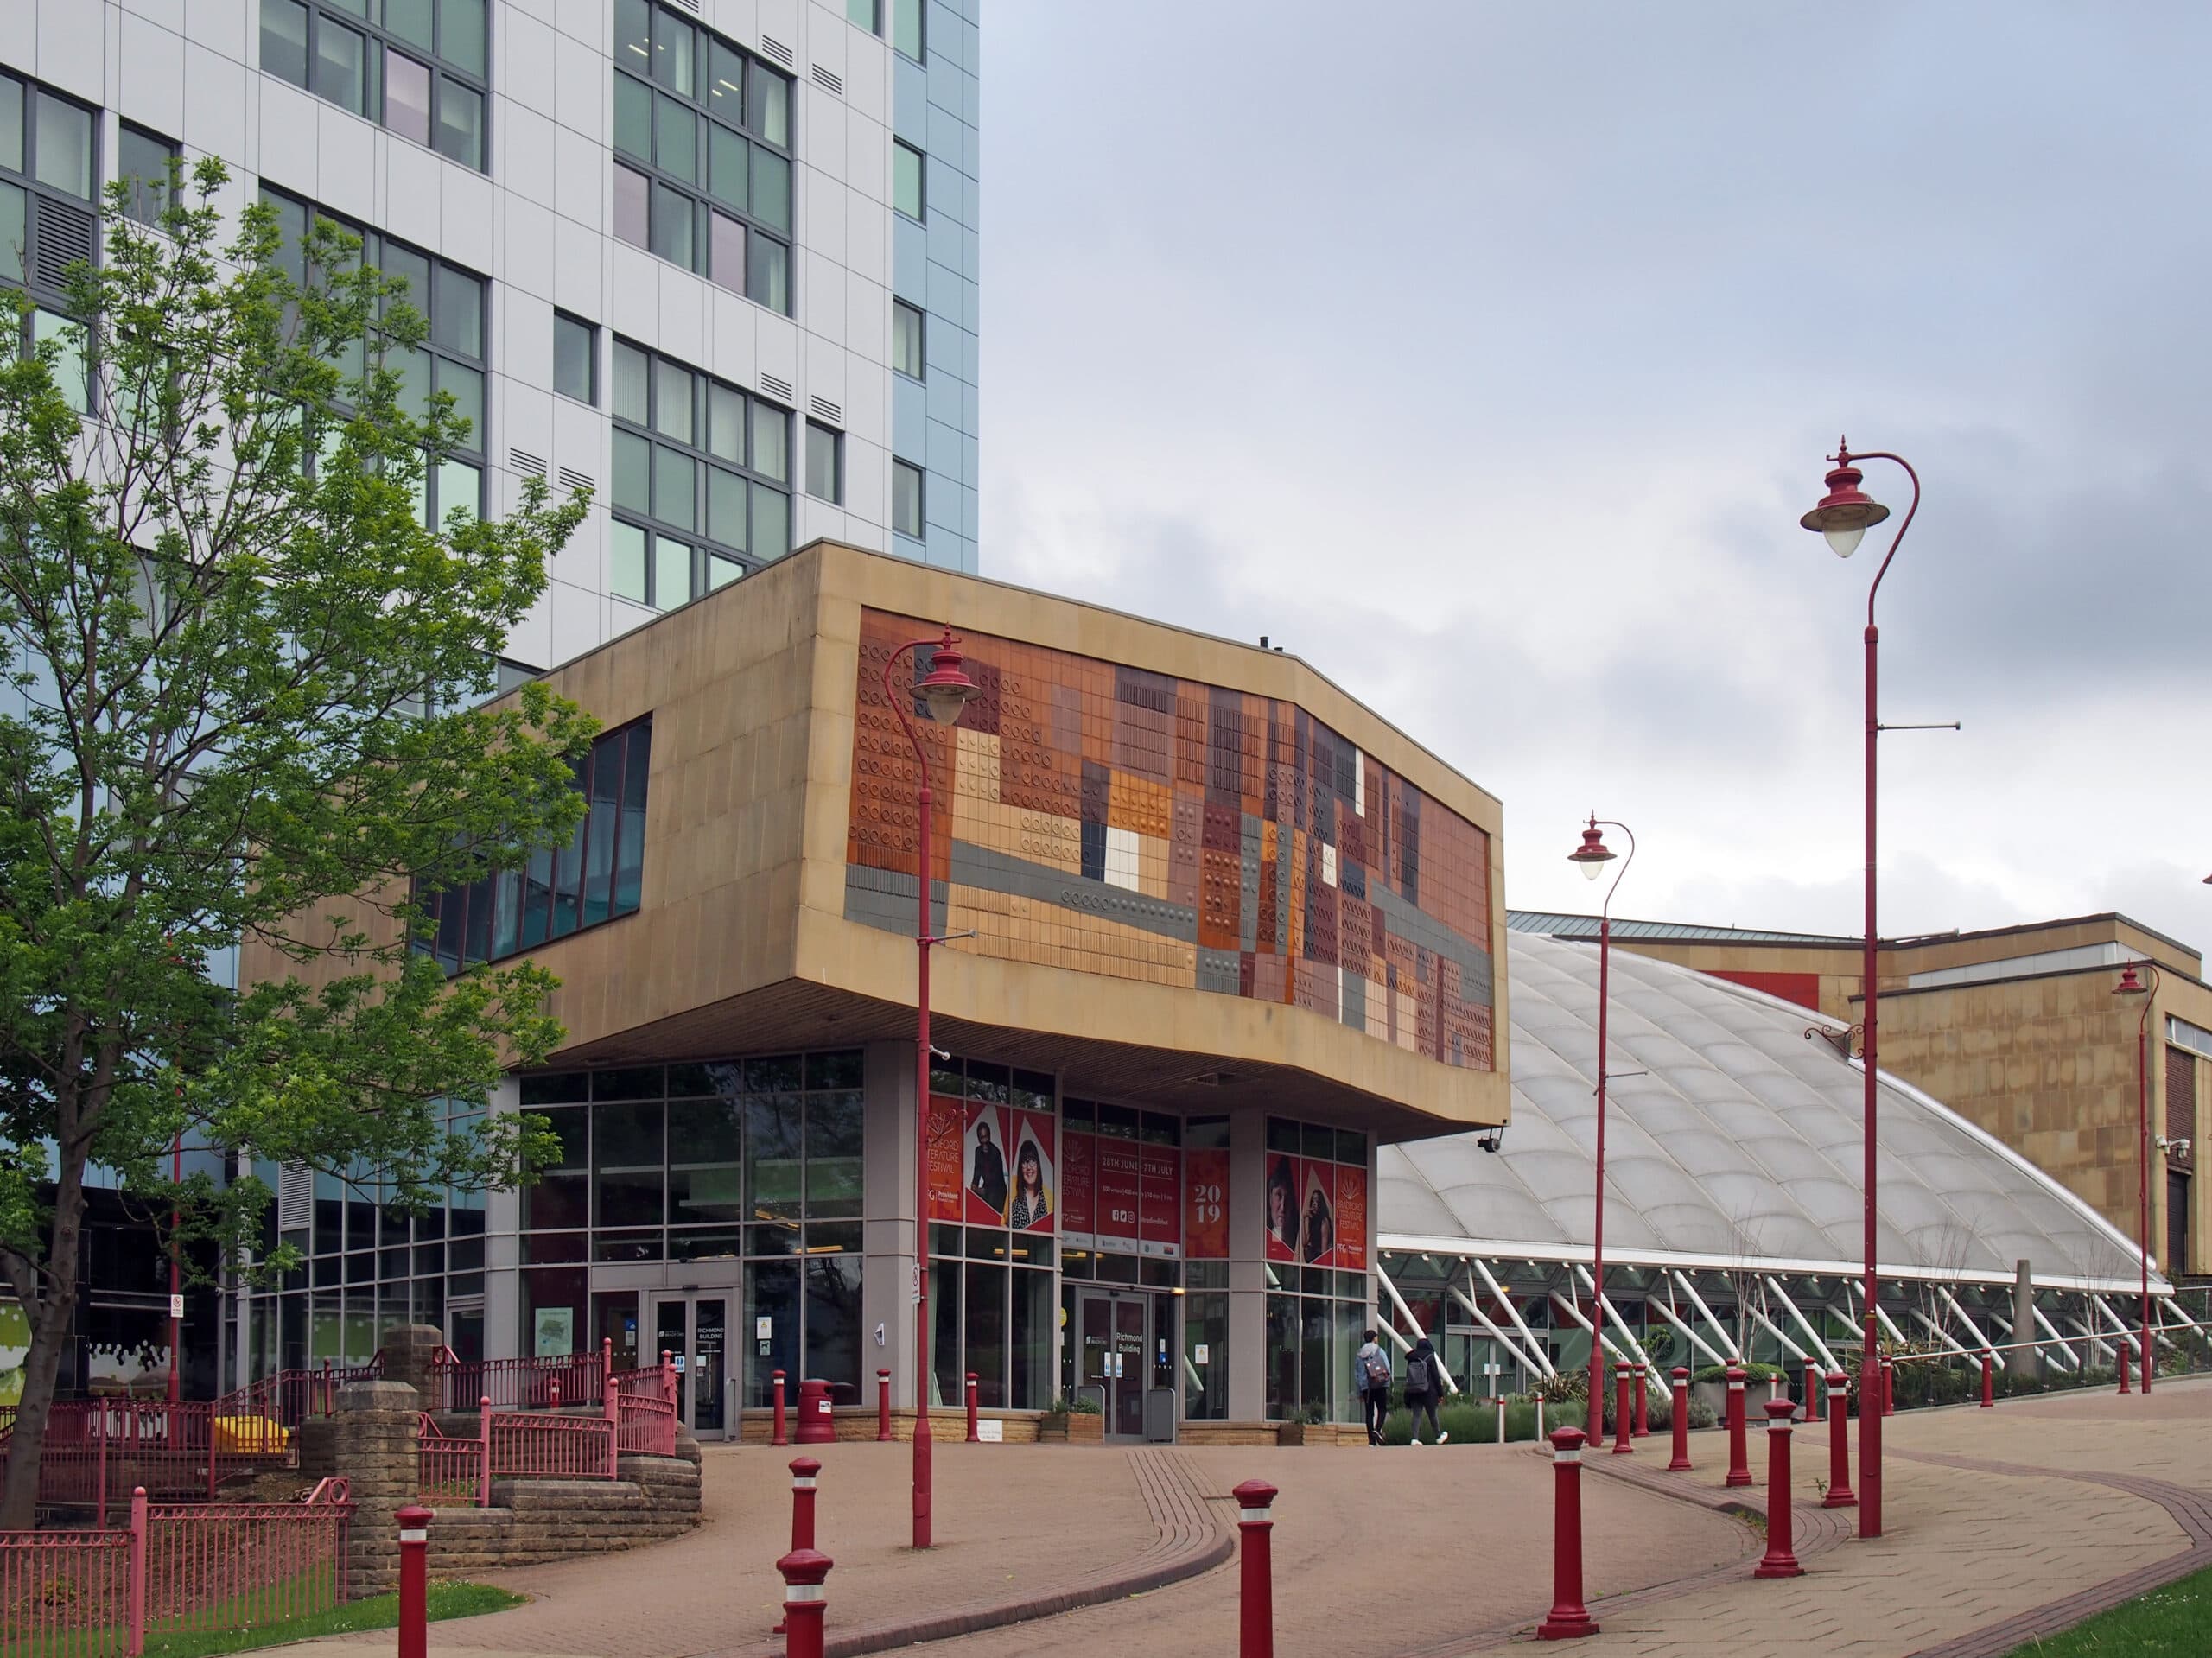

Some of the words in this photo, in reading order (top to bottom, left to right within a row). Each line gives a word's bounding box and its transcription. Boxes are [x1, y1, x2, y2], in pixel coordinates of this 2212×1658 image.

[928, 1137, 959, 1151] DFORD
[927, 1148, 959, 1163] TERATURE
[1103, 1156, 1120, 1168] 28TH
[1158, 1165, 1173, 1175] JULY
[1063, 1174, 1090, 1188] ERATURE
[1062, 1185, 1085, 1198] ESTIVAL
[1194, 1185, 1221, 1203] 20
[1196, 1204, 1221, 1223] 19
[1116, 1332, 1143, 1343] Richmond
[1119, 1344, 1141, 1355] Building
